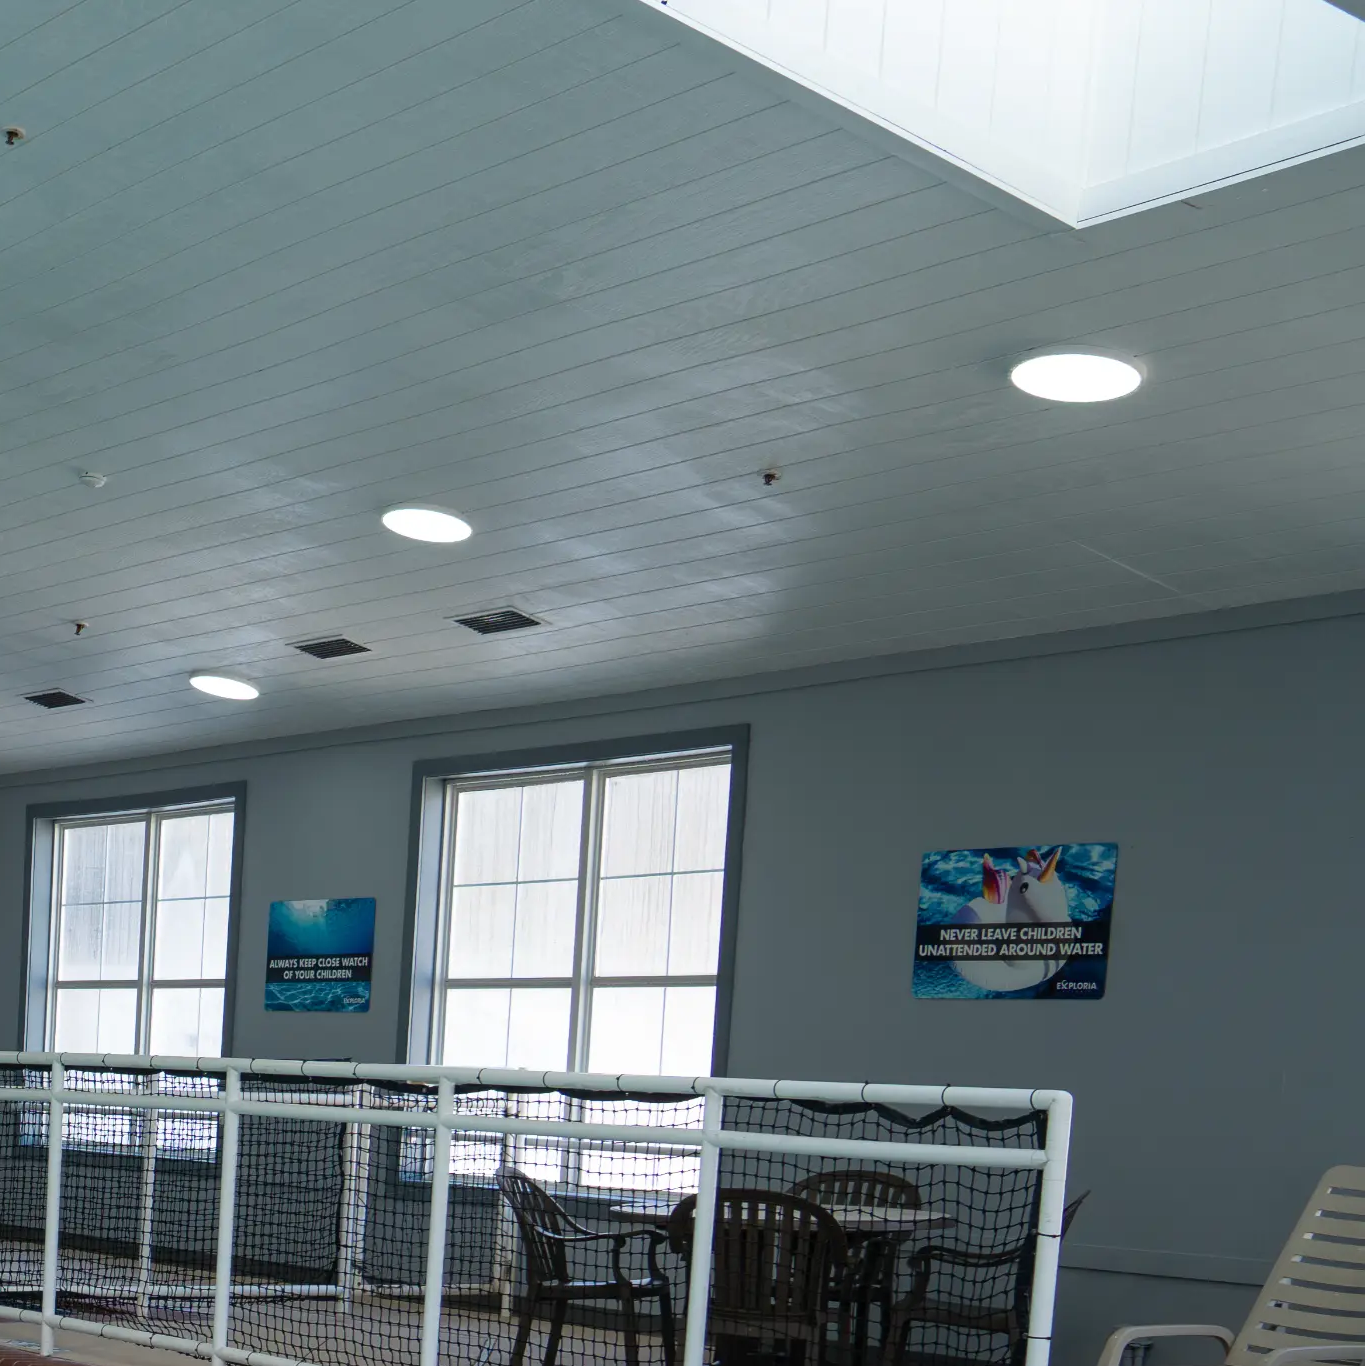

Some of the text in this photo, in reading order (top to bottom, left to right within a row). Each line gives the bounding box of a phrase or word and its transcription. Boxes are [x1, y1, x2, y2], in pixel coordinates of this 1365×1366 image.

[940, 927, 1082, 941] NEVER LEAVE CHILDREN
[919, 943, 1103, 956] UNATTENDED AROUND WATER
[270, 957, 368, 968] ALWAYS KEEP CLOSE WATCH
[283, 969, 352, 979] OF YOUR CHILDREN
[1057, 980, 1097, 990] EXPLORIA
